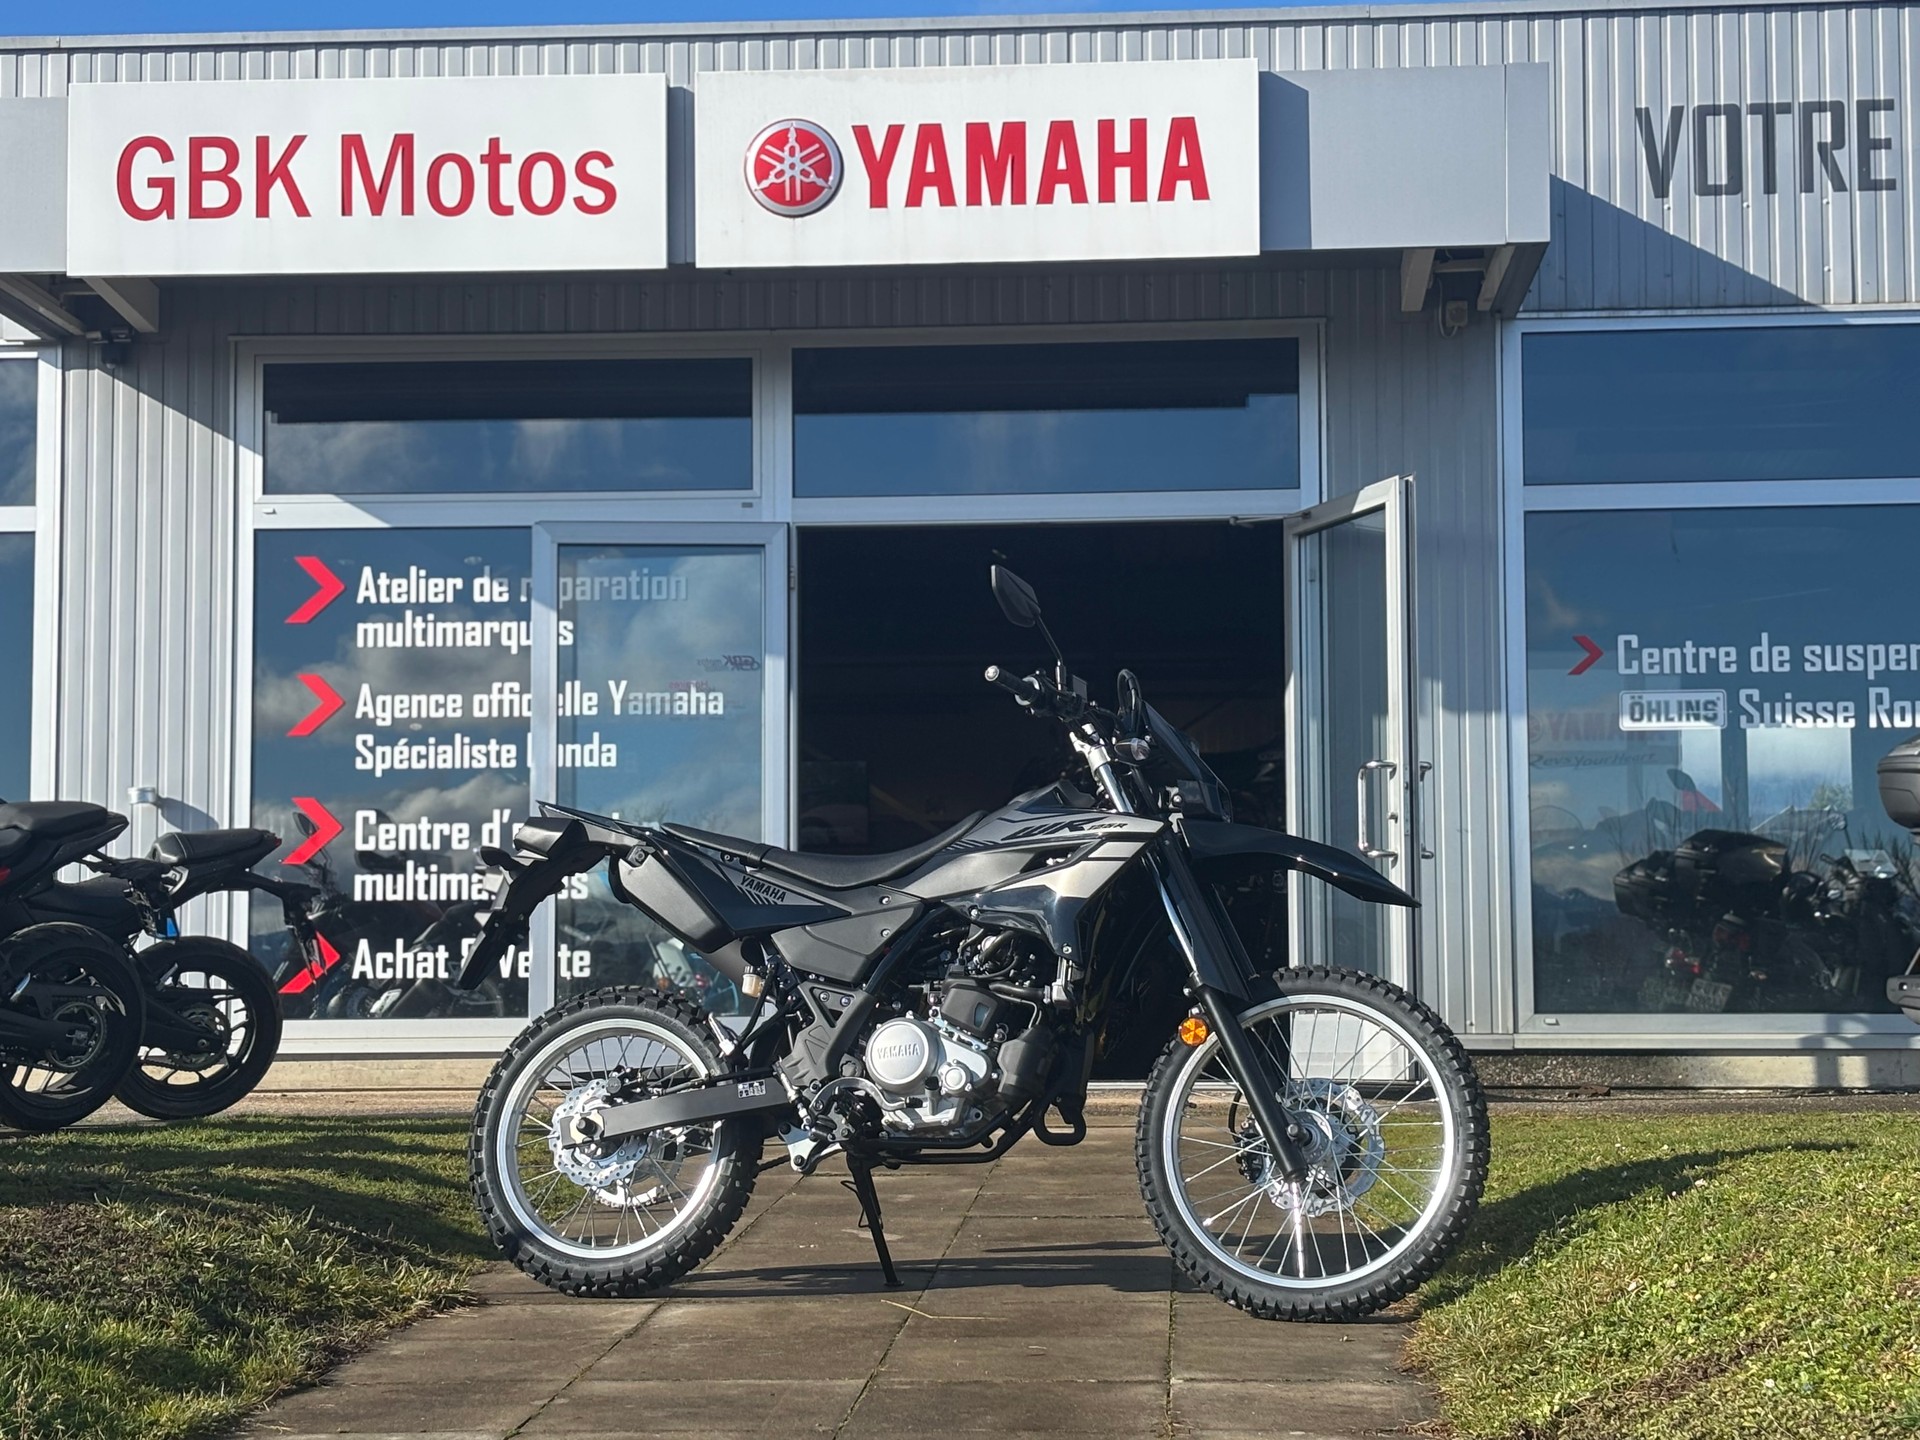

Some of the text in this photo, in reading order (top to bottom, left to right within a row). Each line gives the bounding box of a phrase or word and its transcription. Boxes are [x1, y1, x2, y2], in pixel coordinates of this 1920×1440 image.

[851, 116, 1211, 209] YAMAHA
[1635, 98, 1897, 199] VOTRE
[116, 132, 618, 222] GBK Motos
[356, 565, 687, 610] Atelier de rparation
[356, 609, 574, 655] multimarqus
[1617, 634, 1737, 675] Centre
[1750, 632, 1791, 673] de
[355, 680, 724, 727] Agence officlle Yamaha
[1628, 695, 1719, 723] ÖHLINS
[1738, 688, 1855, 729] Suisse
[355, 731, 617, 777] Spécialiste nda
[355, 809, 470, 851] Centre
[740, 875, 788, 903] YAMAHA
[351, 938, 449, 980] Achat
[499, 943, 591, 979] Vete
[876, 1043, 921, 1060] YAMAHA
